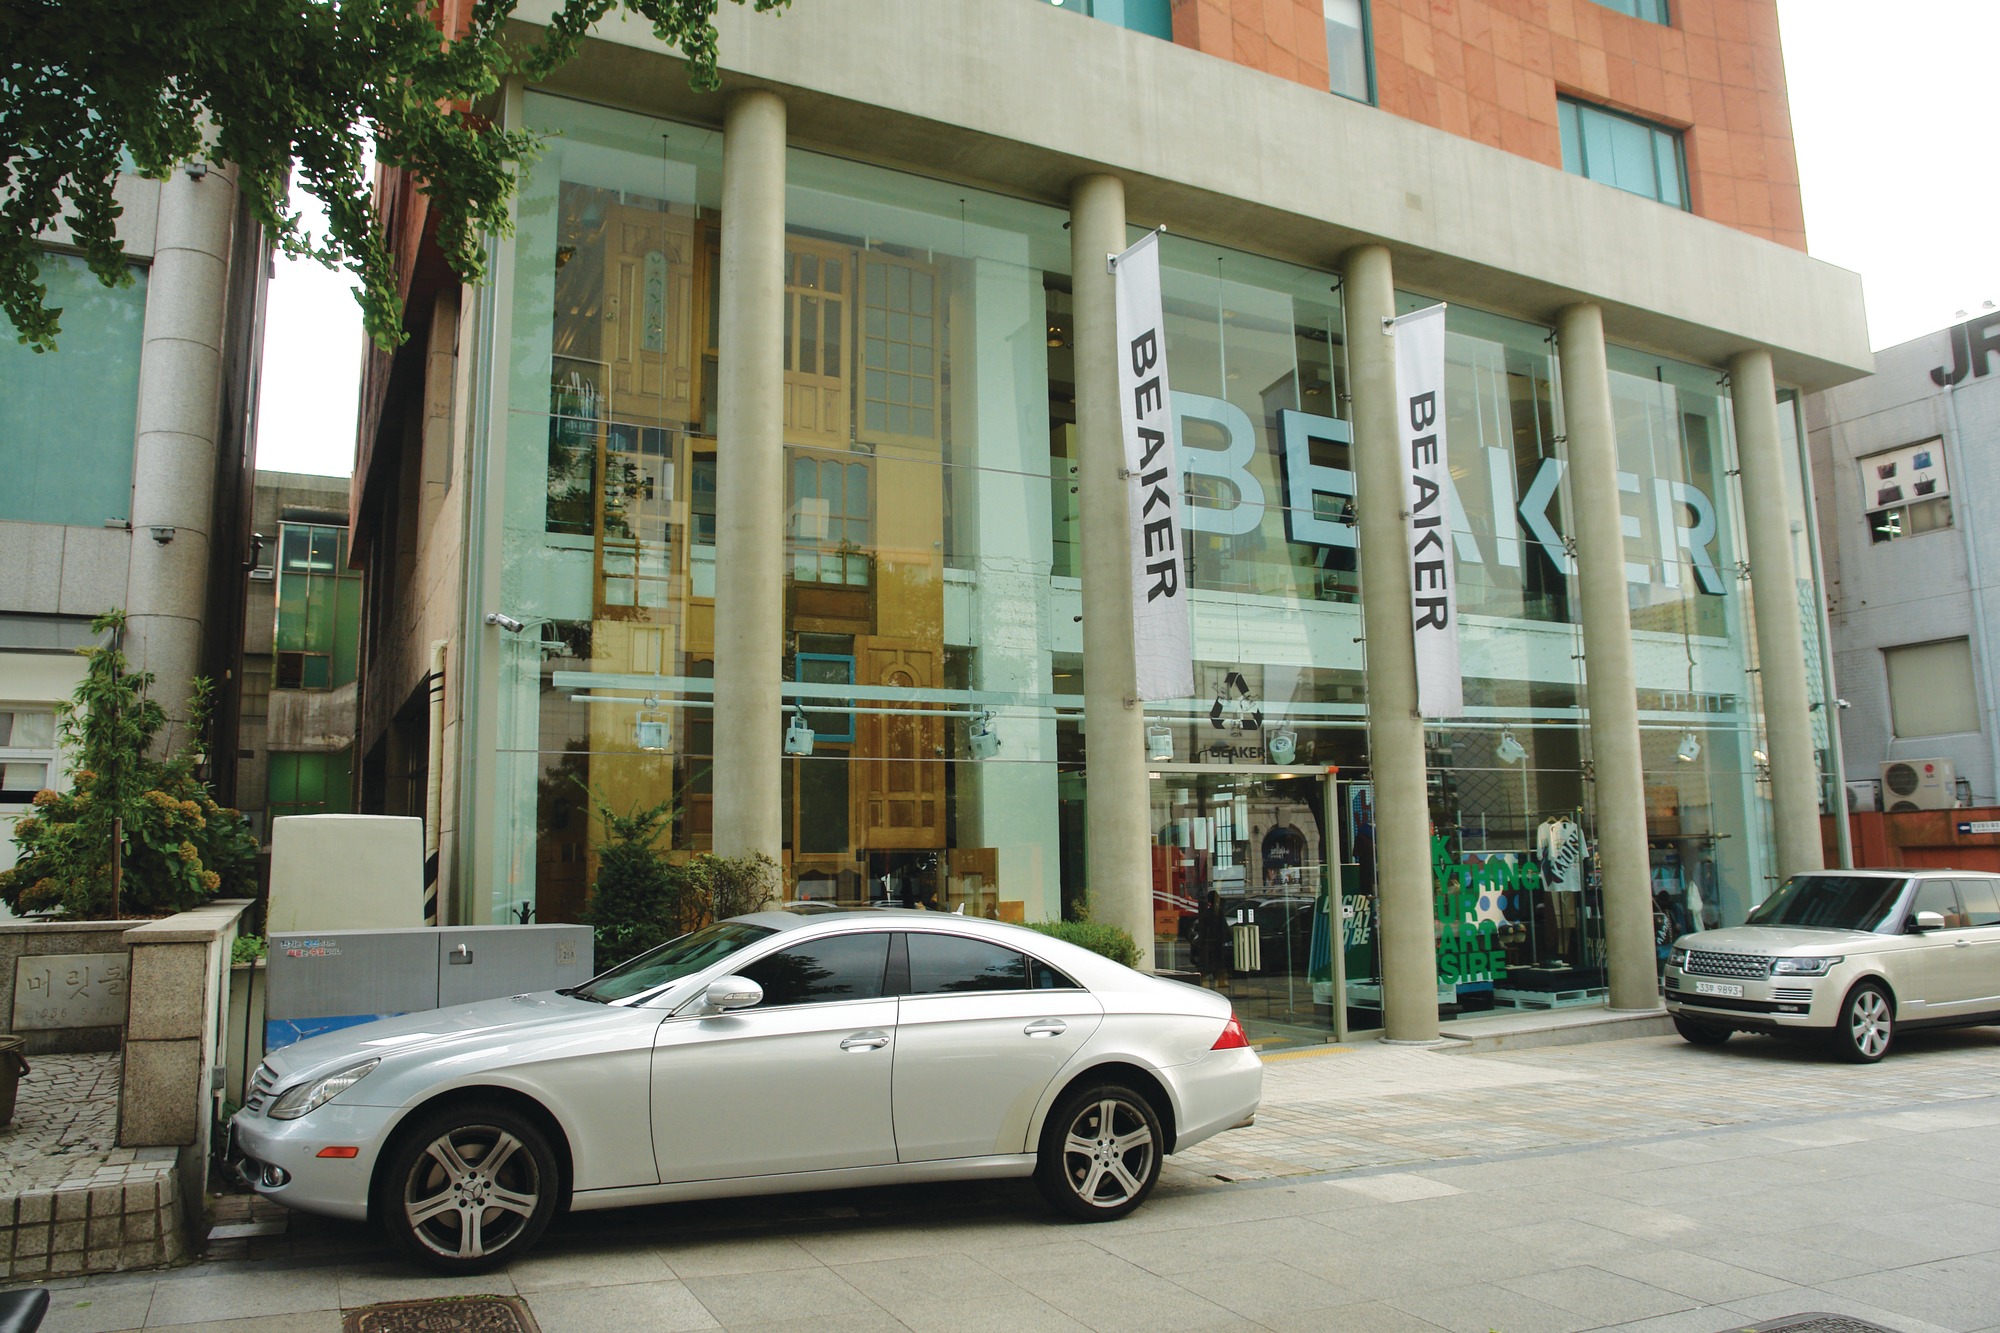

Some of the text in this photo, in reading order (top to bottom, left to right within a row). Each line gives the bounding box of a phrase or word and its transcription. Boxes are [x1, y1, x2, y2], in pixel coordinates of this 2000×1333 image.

[1130, 327, 1178, 604] BEAKER
[1409, 390, 1449, 632] BEAKER
[1210, 746, 1266, 760] BEAKER
[1433, 861, 1540, 894] YTHING
[1352, 927, 1371, 945] BE
[1436, 917, 1498, 955] ART
[1436, 950, 1507, 986] SIRE
[1717, 985, 1739, 996] 9893
